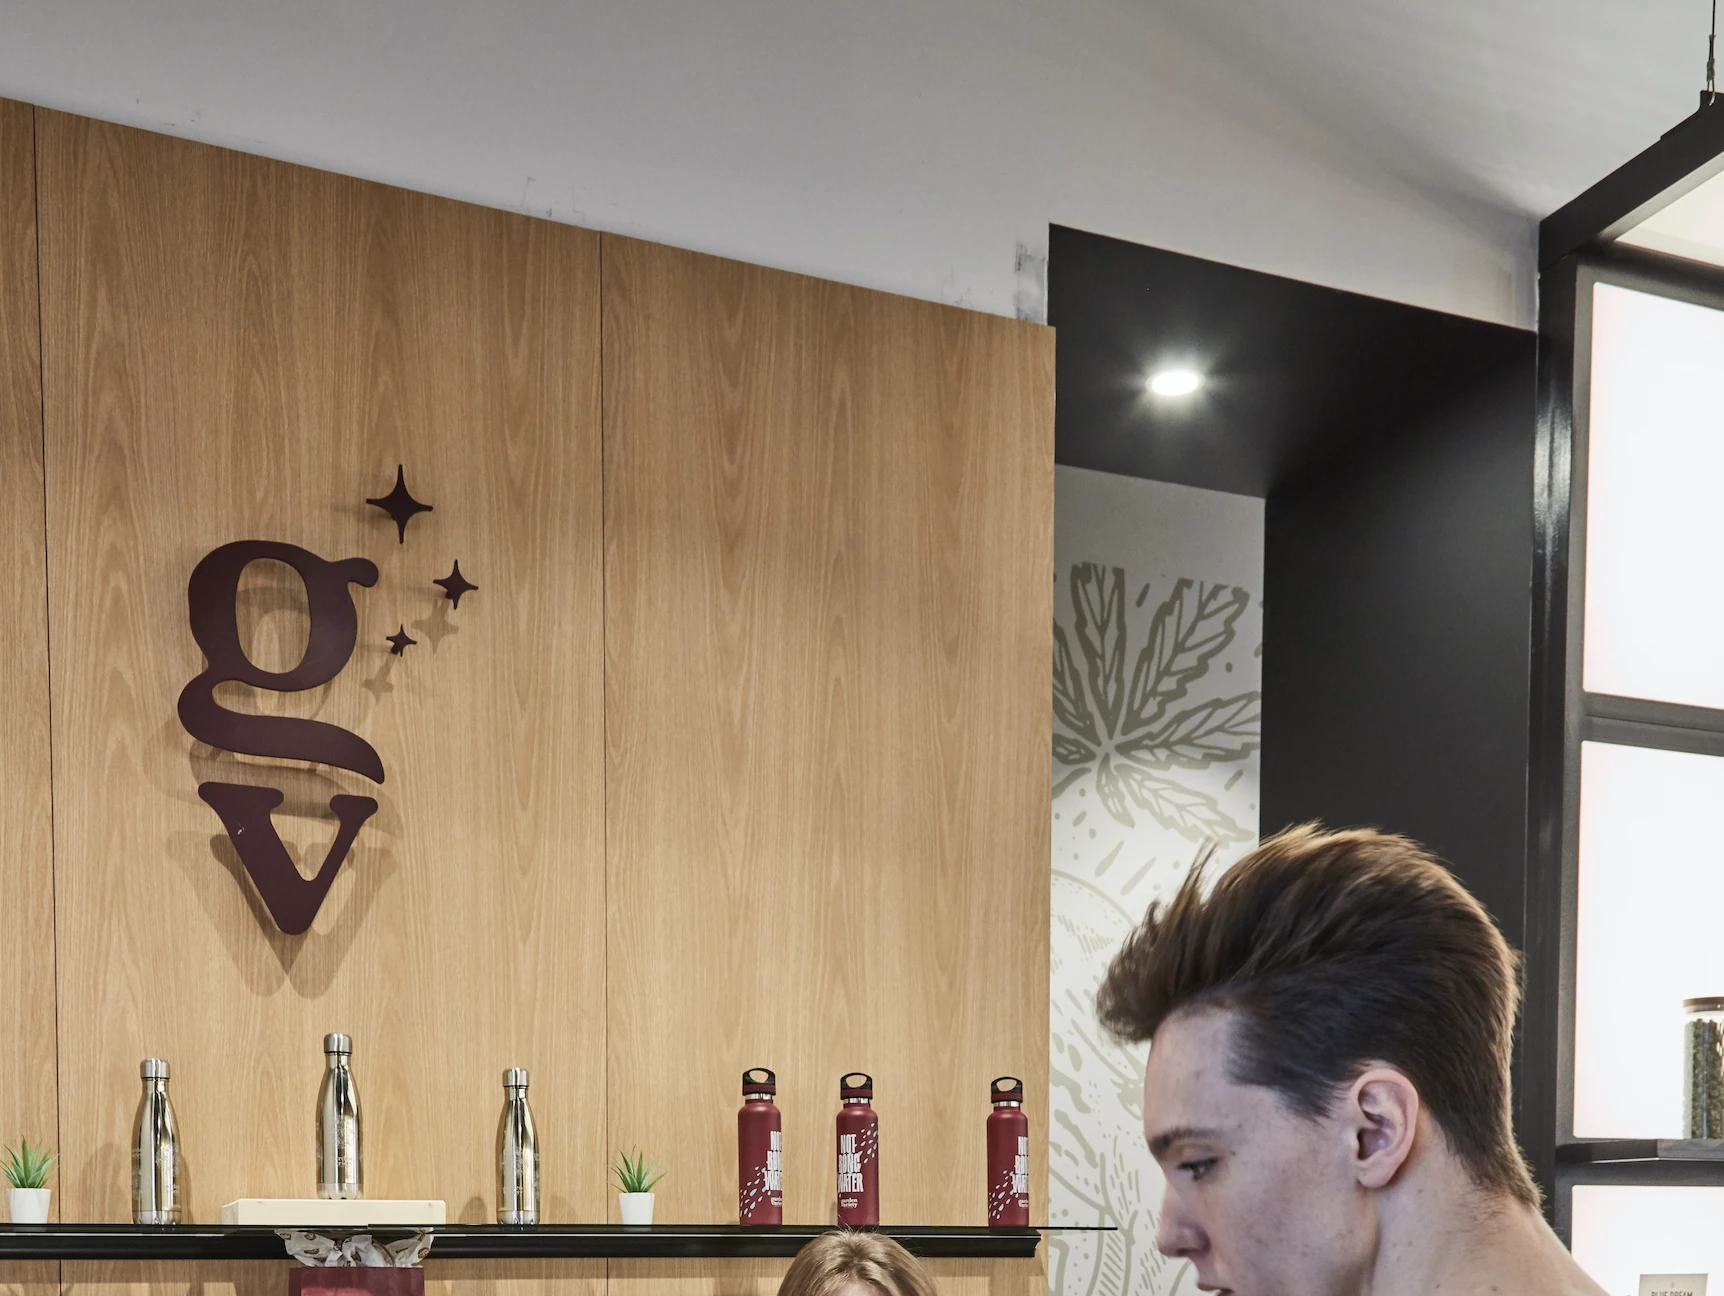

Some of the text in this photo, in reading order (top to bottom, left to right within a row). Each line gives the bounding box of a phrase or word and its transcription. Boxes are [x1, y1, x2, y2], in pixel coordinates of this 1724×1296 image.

[178, 540, 385, 785] g
[840, 1134, 856, 1153] NOT
[839, 1153, 862, 1172] BONG
[838, 1173, 864, 1192] WATER
